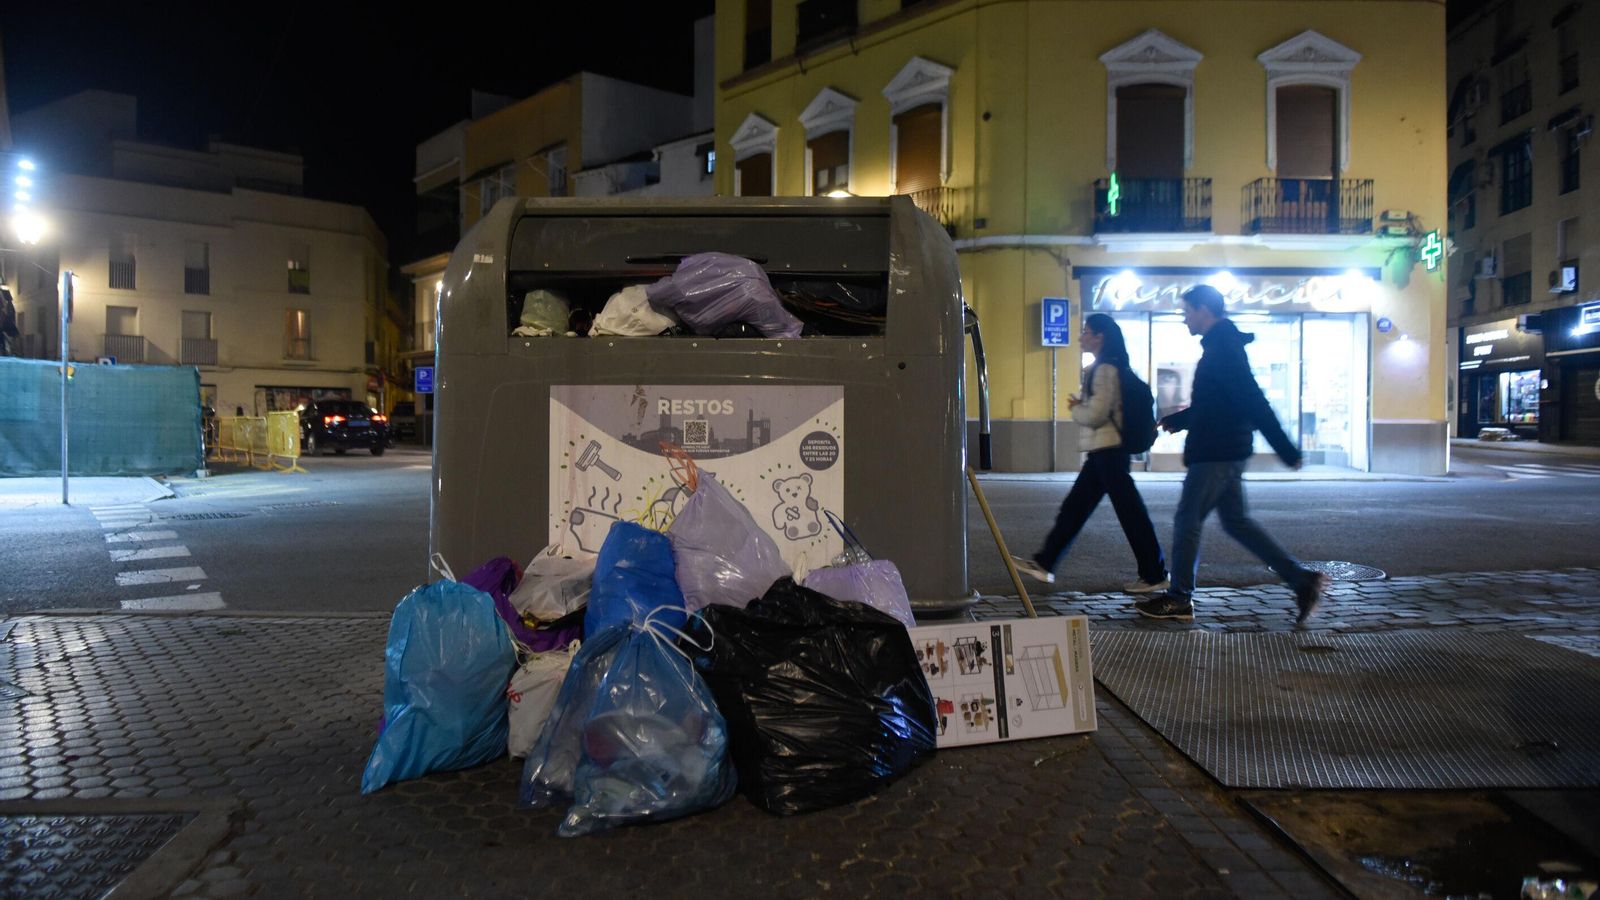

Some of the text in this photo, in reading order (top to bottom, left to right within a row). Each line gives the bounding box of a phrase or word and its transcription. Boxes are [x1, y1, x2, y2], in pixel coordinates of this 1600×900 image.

[1050, 304, 1063, 323] P
[420, 371, 428, 380] P
[658, 399, 734, 415] RESTOS
